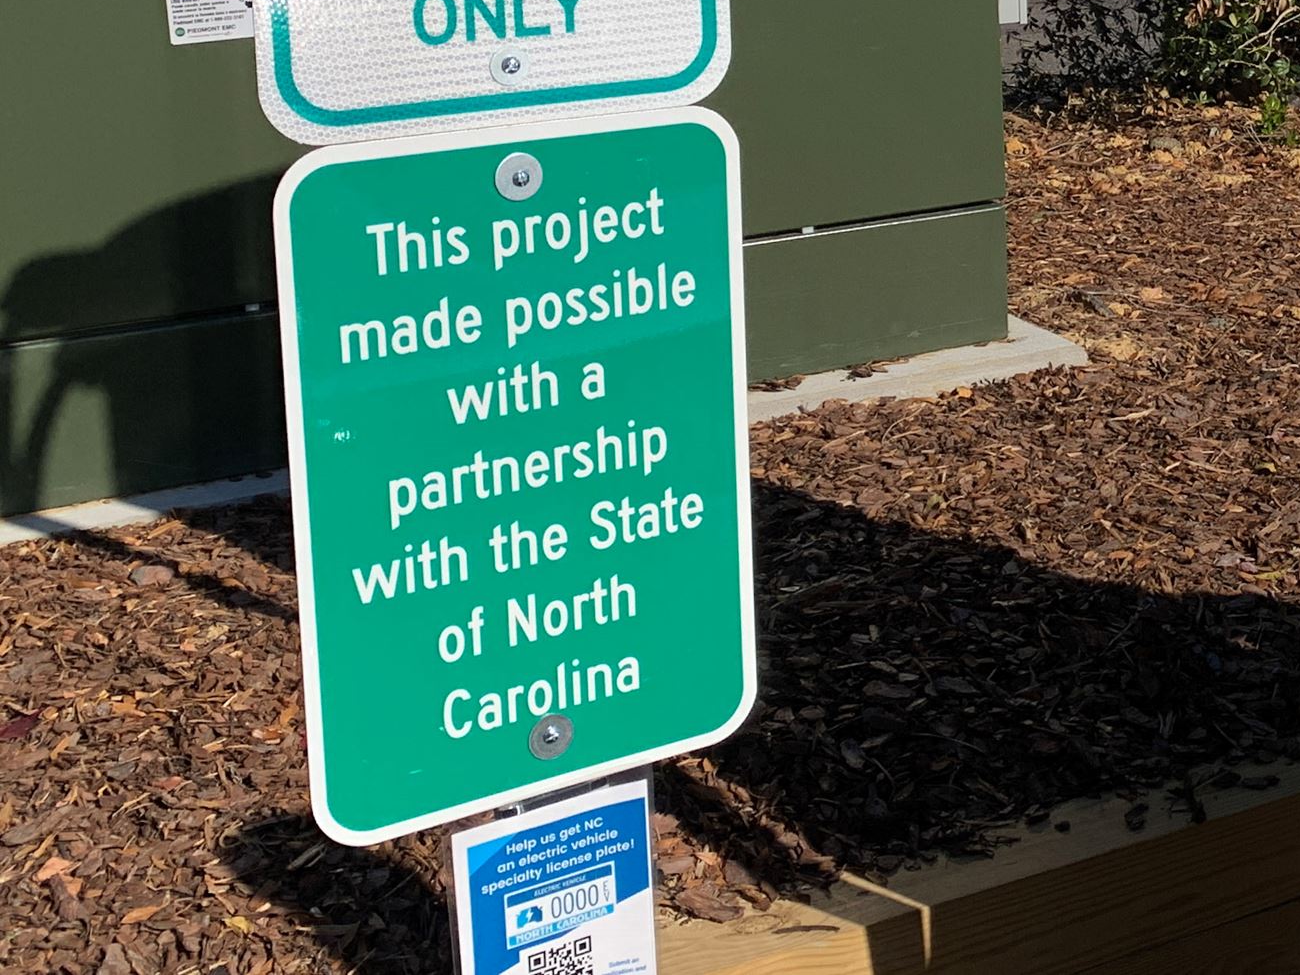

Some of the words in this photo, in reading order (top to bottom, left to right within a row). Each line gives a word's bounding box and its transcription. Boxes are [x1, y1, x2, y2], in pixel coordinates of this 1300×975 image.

[366, 216, 470, 276] This
[492, 187, 665, 271] project
[339, 296, 482, 364] made
[507, 264, 697, 349] possible
[447, 360, 559, 425] with
[581, 362, 606, 400] a
[388, 419, 669, 530] partnership
[352, 536, 469, 605] with
[489, 520, 568, 574] the
[589, 487, 704, 549] State
[437, 606, 486, 664] of
[506, 574, 637, 644] North
[442, 655, 641, 740] Carolina
[481, 867, 542, 895] specialty
[546, 852, 592, 874] license
[596, 838, 635, 862] plate!
[497, 863, 515, 874] an
[518, 844, 568, 867] electric
[571, 830, 618, 850] vehicle
[506, 838, 537, 856] Help
[540, 832, 556, 844] us
[559, 823, 581, 841] get
[584, 817, 604, 830] NC
[534, 883, 561, 897] ELECTRIC
[551, 884, 599, 919] 0000
[516, 924, 555, 944] NORTH
[556, 907, 608, 930] CAROLINA
